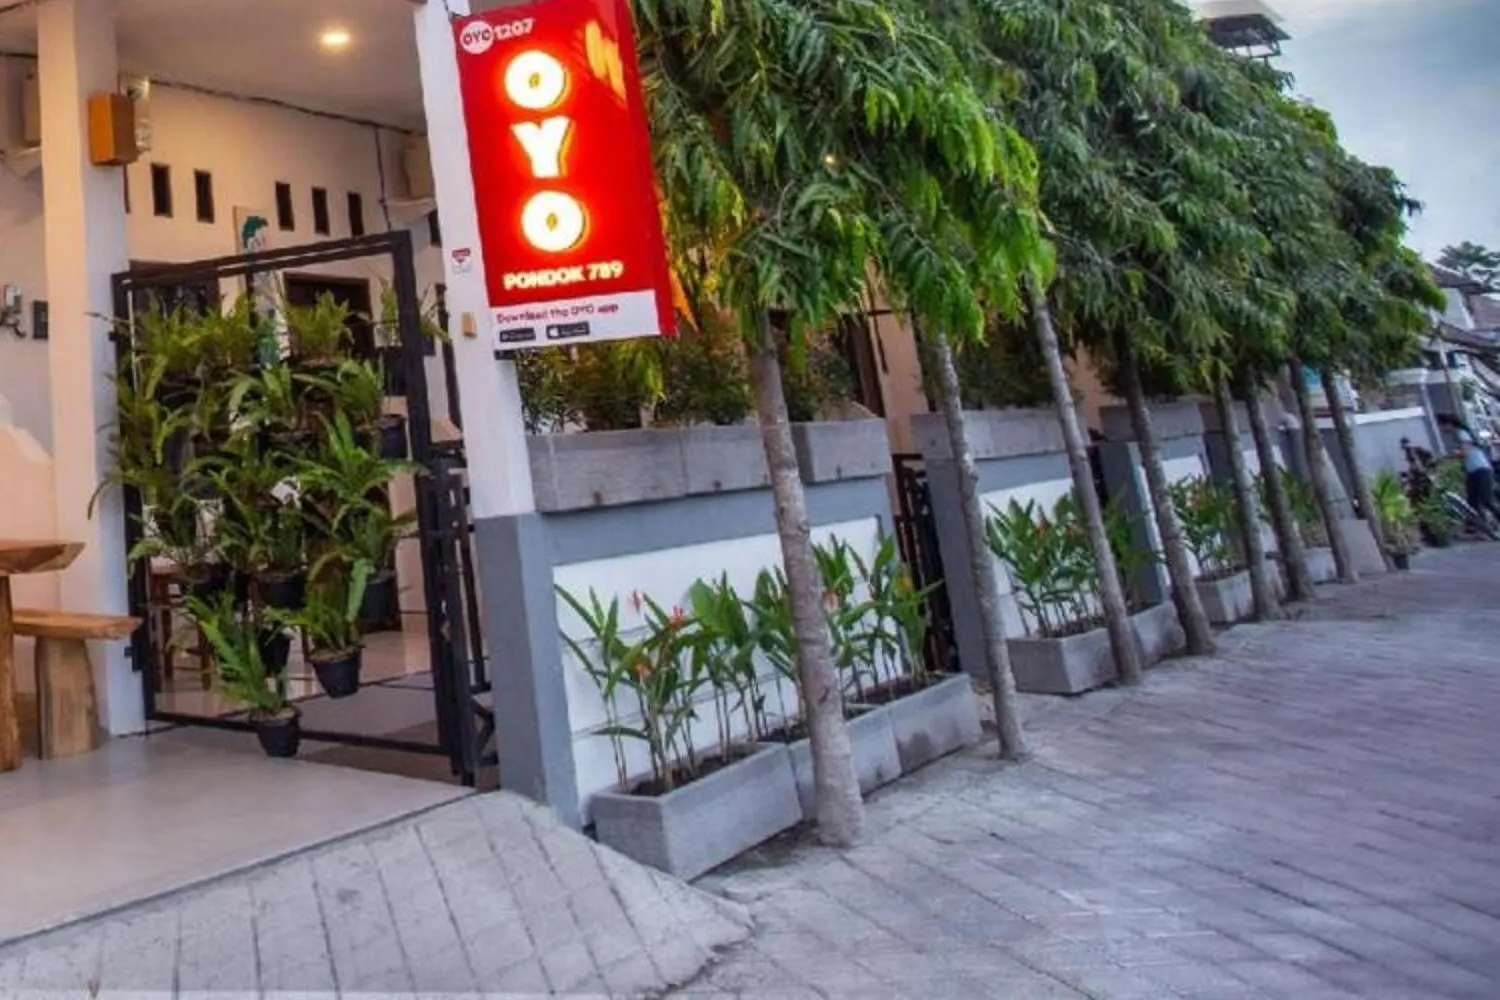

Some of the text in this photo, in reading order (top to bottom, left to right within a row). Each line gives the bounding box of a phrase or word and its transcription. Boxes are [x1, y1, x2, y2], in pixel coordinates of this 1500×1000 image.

[503, 49, 589, 252] OYO
[503, 260, 624, 291] PONDOK 789
